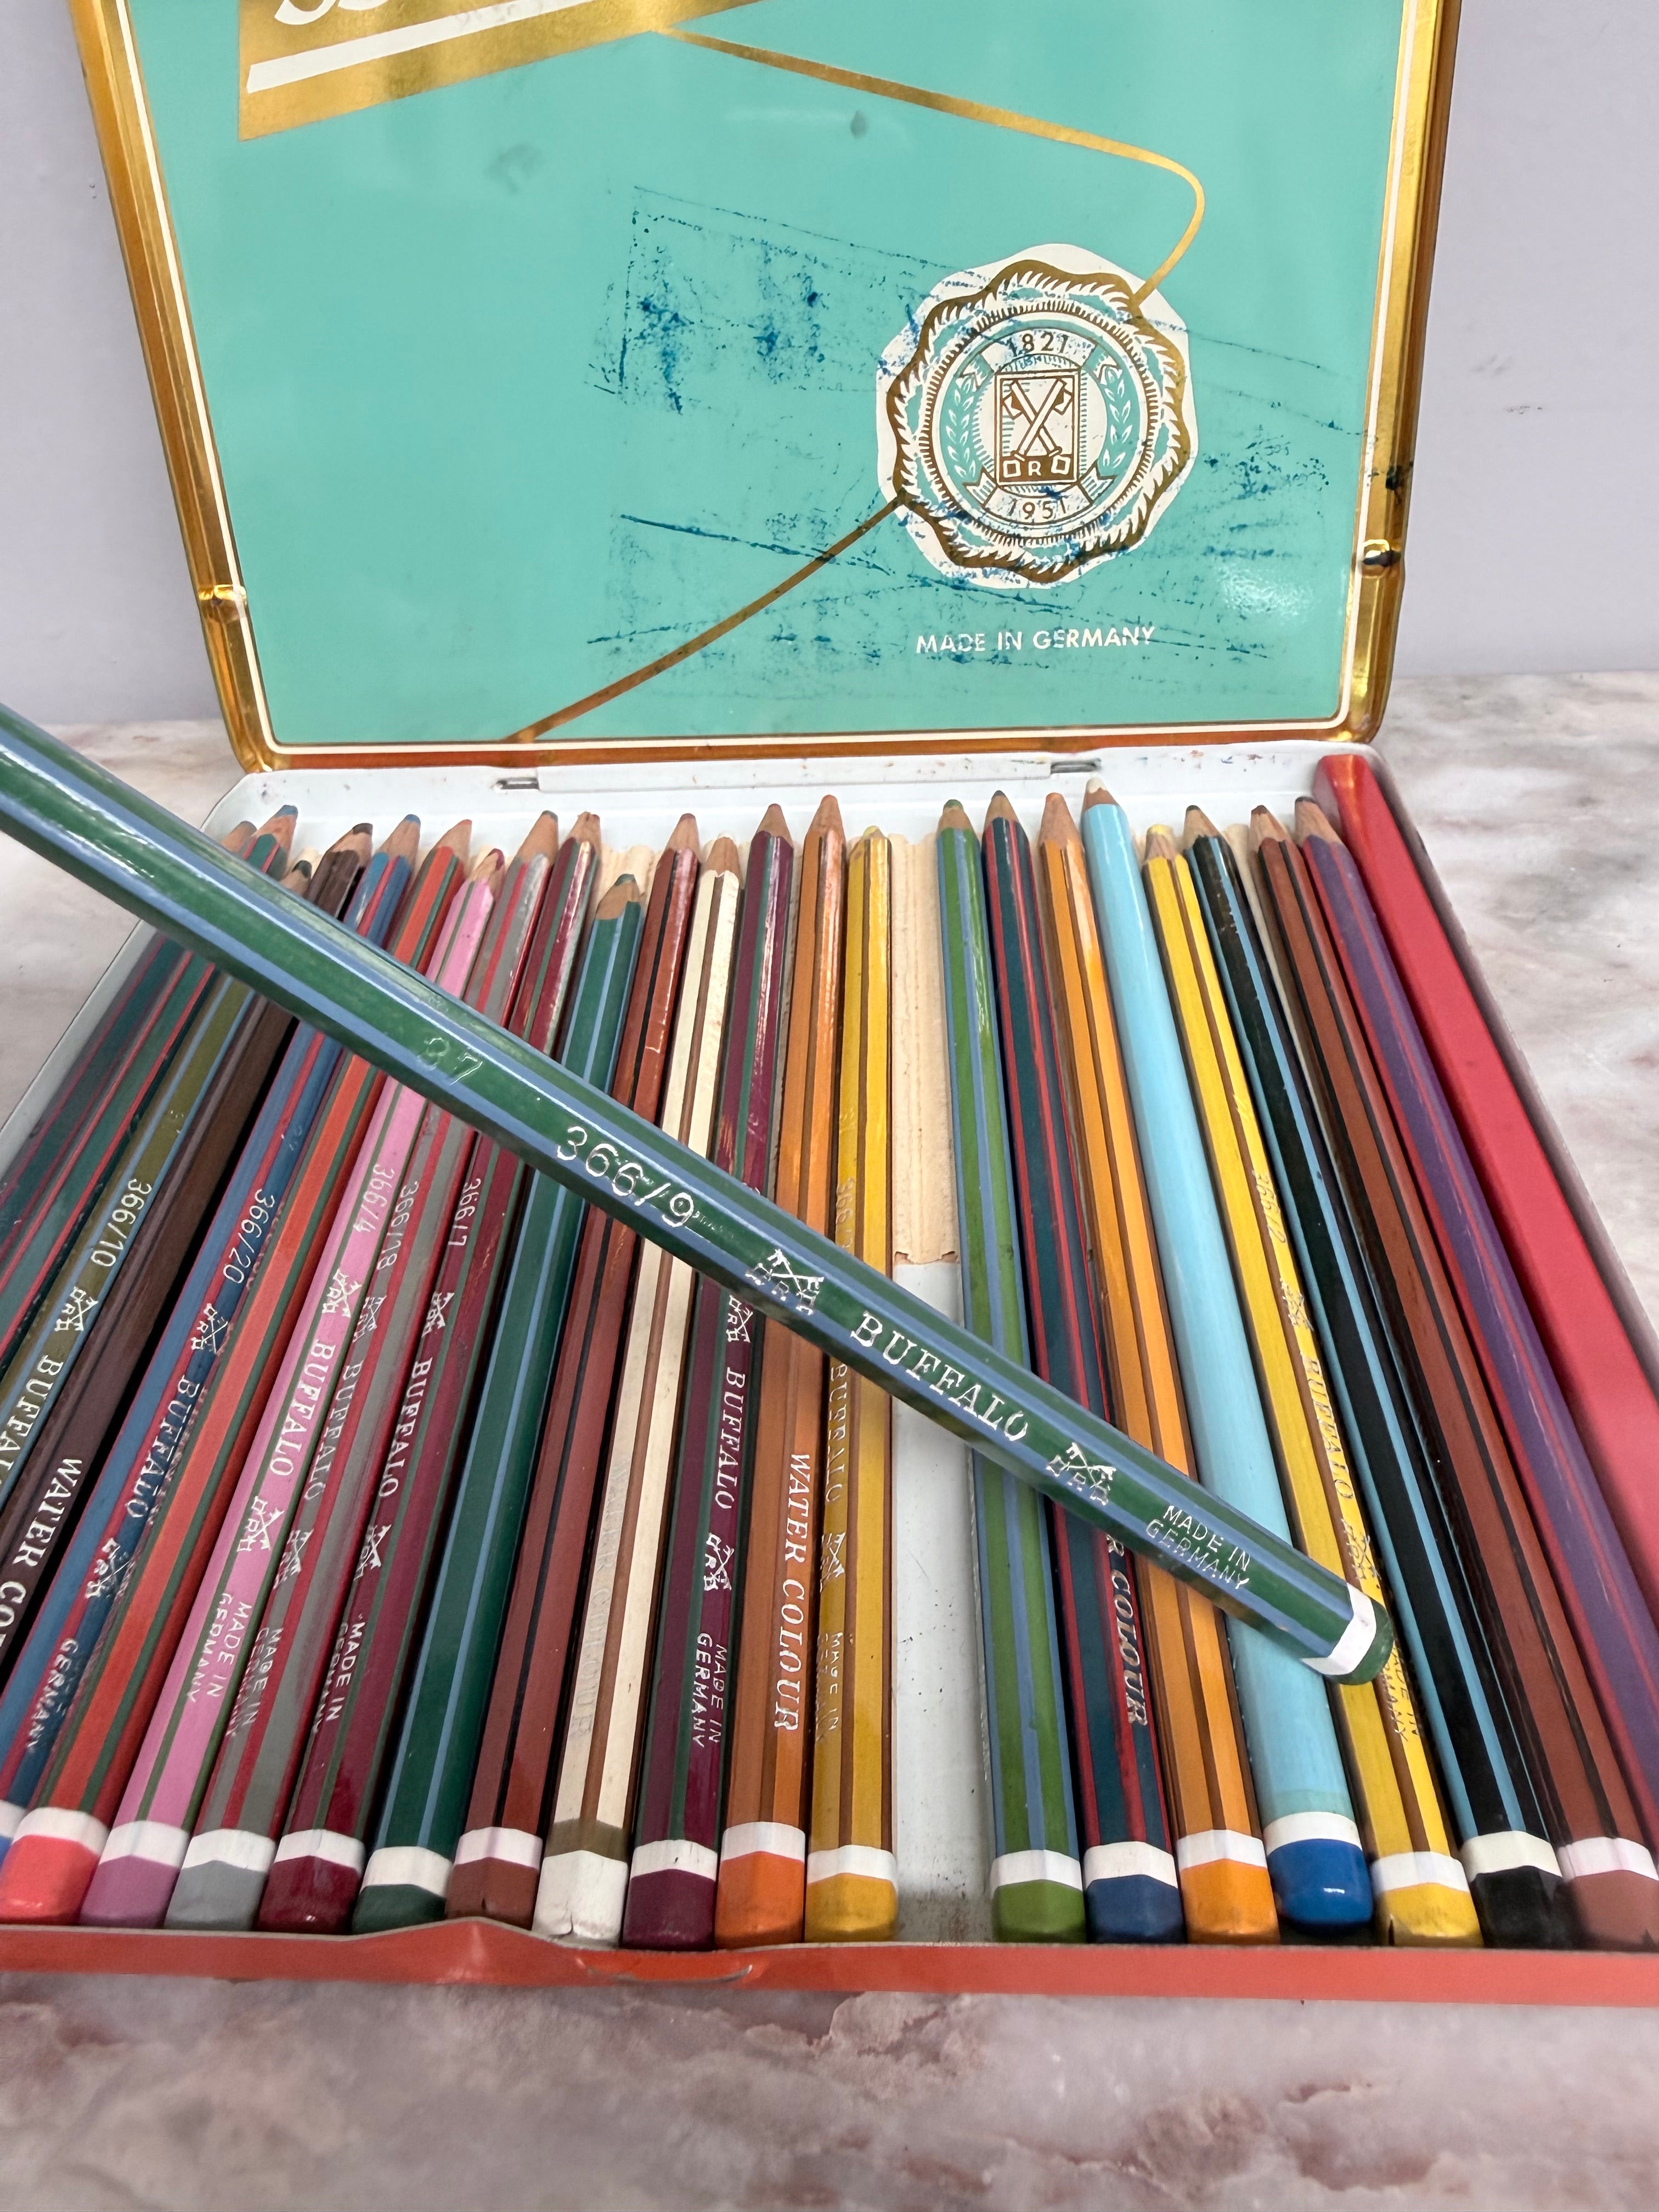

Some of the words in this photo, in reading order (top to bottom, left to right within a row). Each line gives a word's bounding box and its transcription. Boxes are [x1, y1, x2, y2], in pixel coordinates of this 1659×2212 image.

[1009, 497, 1066, 520] 1951
[916, 633, 986, 653] MADE
[997, 631, 1023, 651] IN
[1032, 626, 1155, 650] GERMANY
[91, 1178, 153, 1267] 366/10
[223, 1188, 275, 1284] 366/20
[556, 1126, 694, 1227] 366/9
[850, 1311, 1028, 1442] BUFFALO
[1163, 1505, 1224, 1553] MADE
[1228, 1545, 1251, 1571] IN
[269, 1339, 336, 1476] BUFFALO
[304, 1359, 364, 1500] BUFFALO
[379, 1357, 433, 1498] BUFFALO
[714, 1367, 746, 1509] BUFFALO
[13, 1458, 83, 1567] WATER
[785, 1453, 811, 1563] WATER
[1146, 1519, 1250, 1590] GERMANY
[216, 1601, 252, 1666] MADE
[252, 1627, 284, 1694] MADE
[335, 1622, 366, 1688] MADE
[710, 1644, 727, 1710] MADE
[774, 1582, 806, 1731] COLOUR
[1111, 1569, 1148, 1725] COLOUR
[206, 1674, 227, 1697] IN
[242, 1702, 261, 1726] IN
[326, 1697, 345, 1722] IN
[692, 1633, 713, 1748] GERMANY
[708, 1718, 723, 1744] IN
